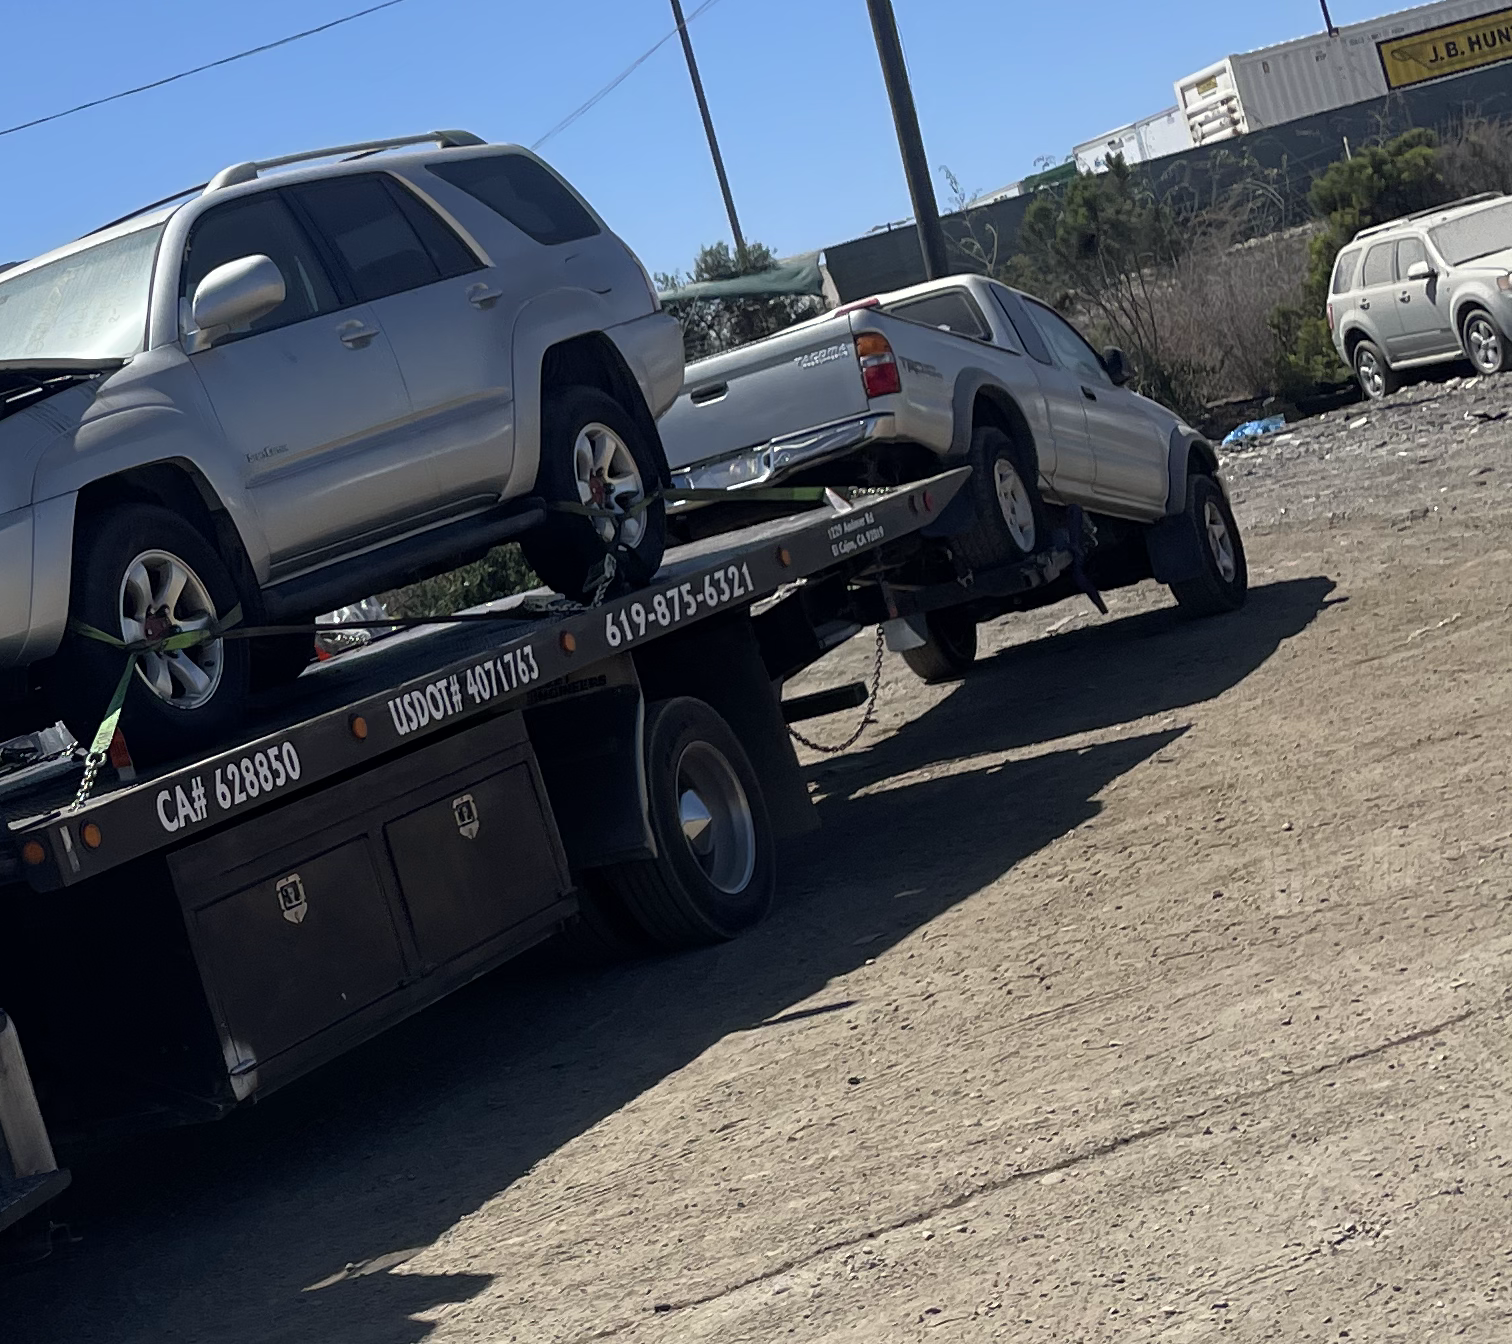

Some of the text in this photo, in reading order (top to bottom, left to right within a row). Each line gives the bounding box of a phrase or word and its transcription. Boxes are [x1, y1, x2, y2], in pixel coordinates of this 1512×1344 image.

[1429, 26, 1512, 64] J.B. HUN
[856, 533, 867, 546] CA
[605, 561, 755, 647] 619-875-6321
[388, 644, 541, 736] USDOT# 4071763
[156, 741, 301, 833] CA# 628850
